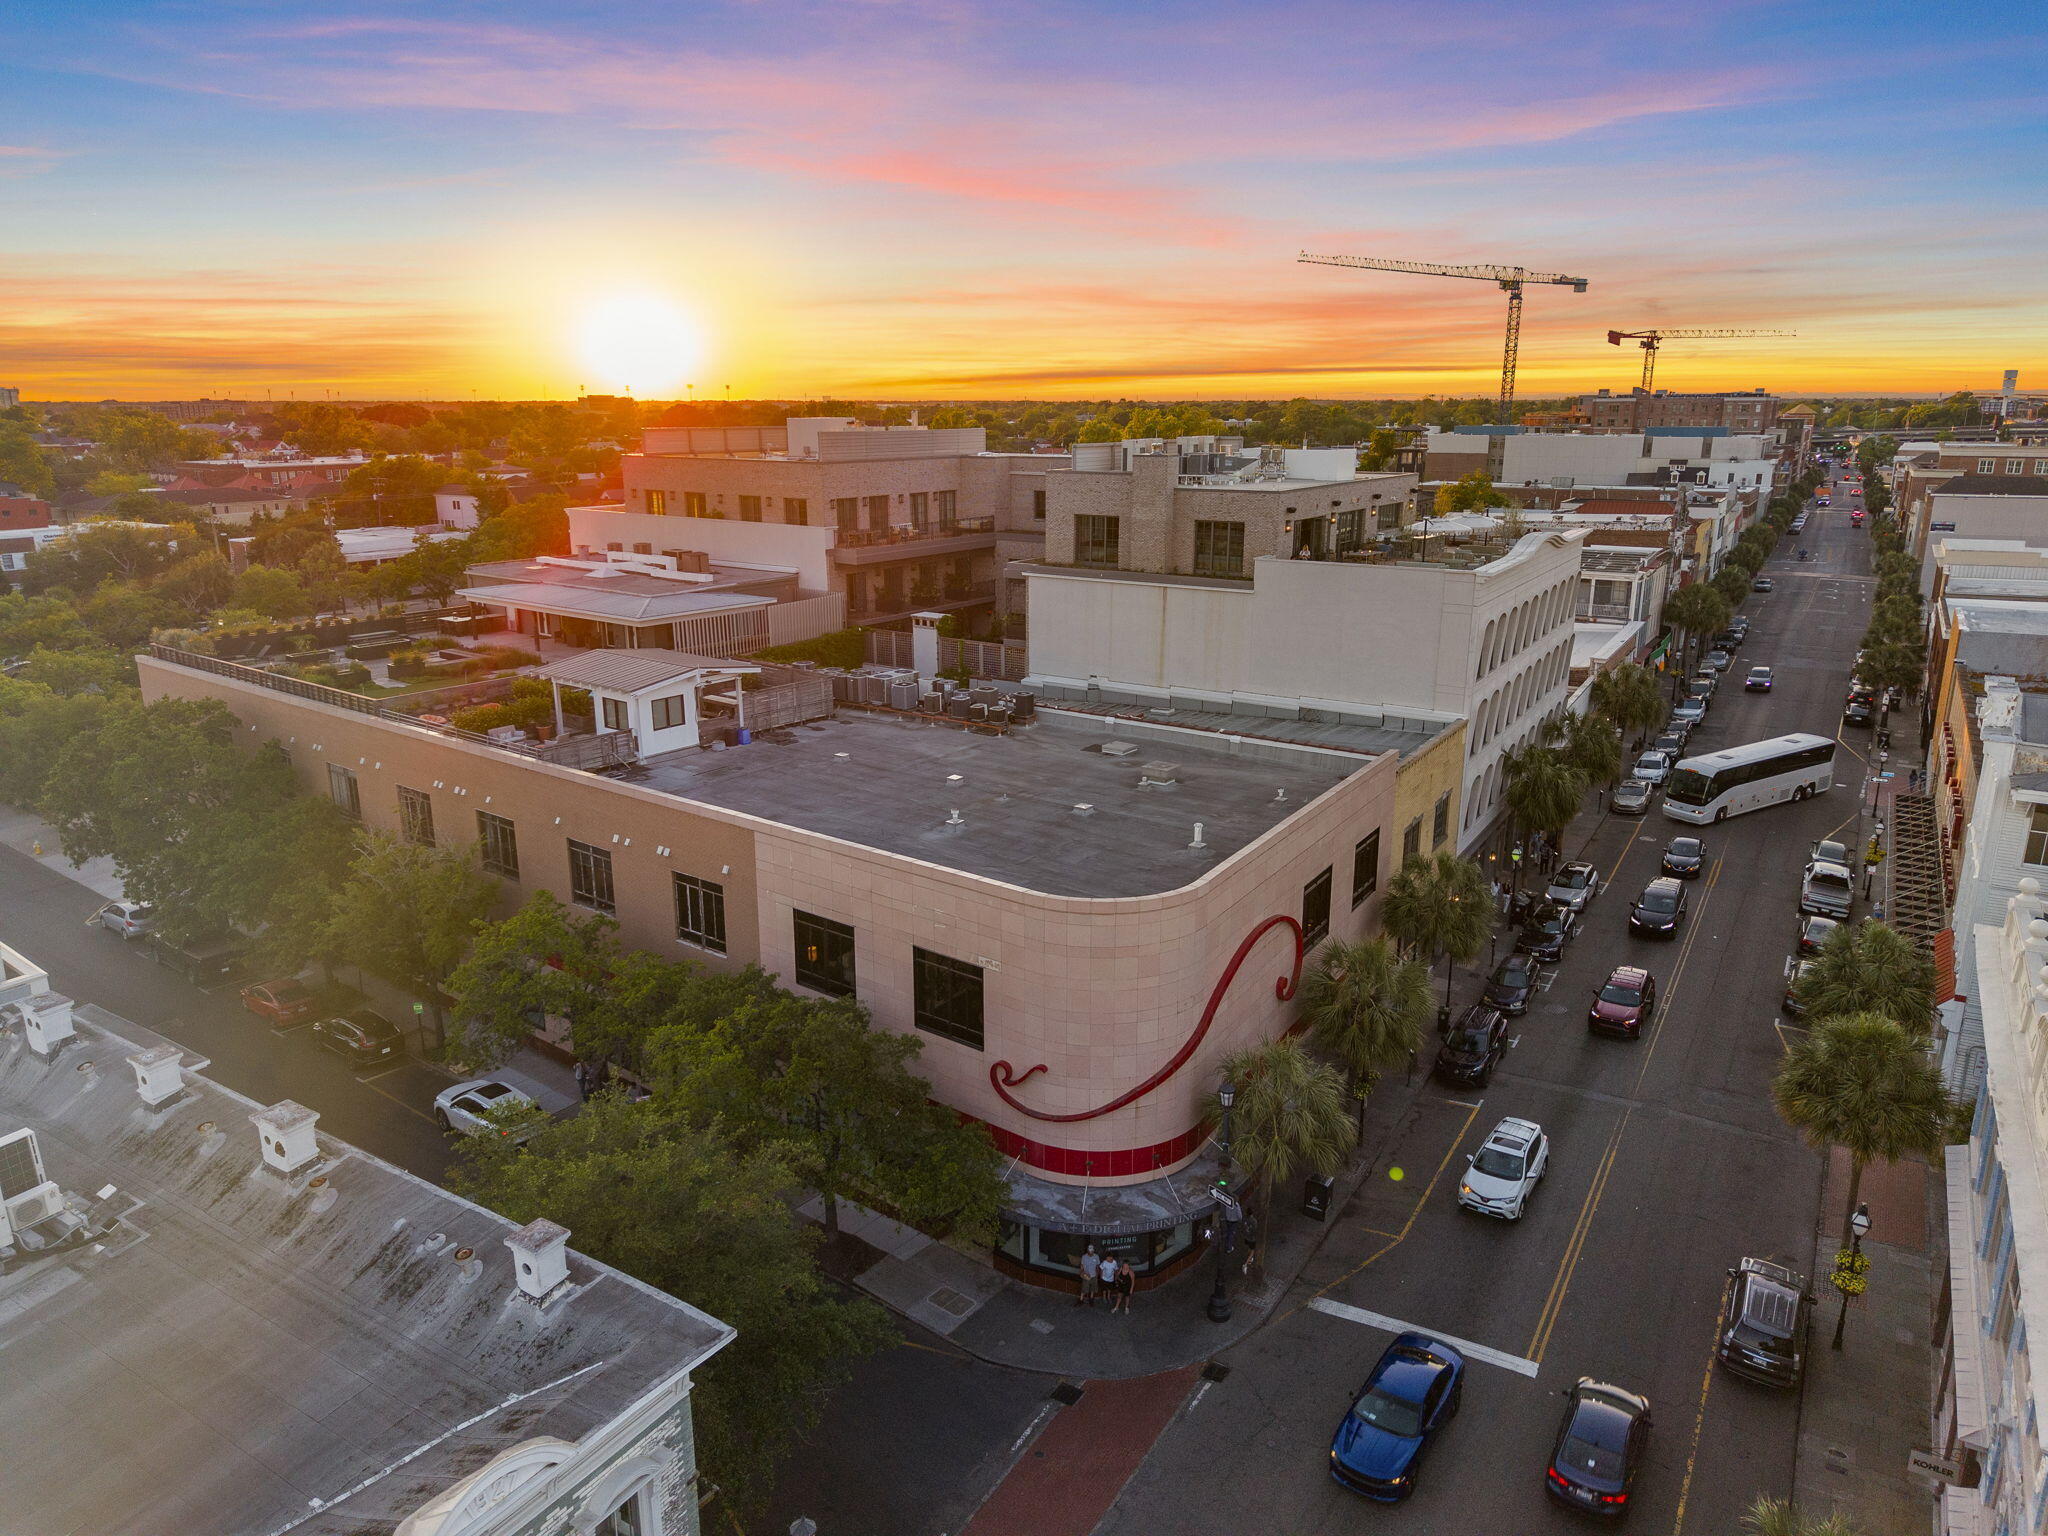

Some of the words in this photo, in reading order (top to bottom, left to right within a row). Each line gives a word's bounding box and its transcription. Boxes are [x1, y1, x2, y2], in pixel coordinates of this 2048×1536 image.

[1146, 1212, 1197, 1231] PRINTING
[1102, 1236, 1137, 1246] PRINTING
[1912, 1458, 1955, 1478] KOHLER
